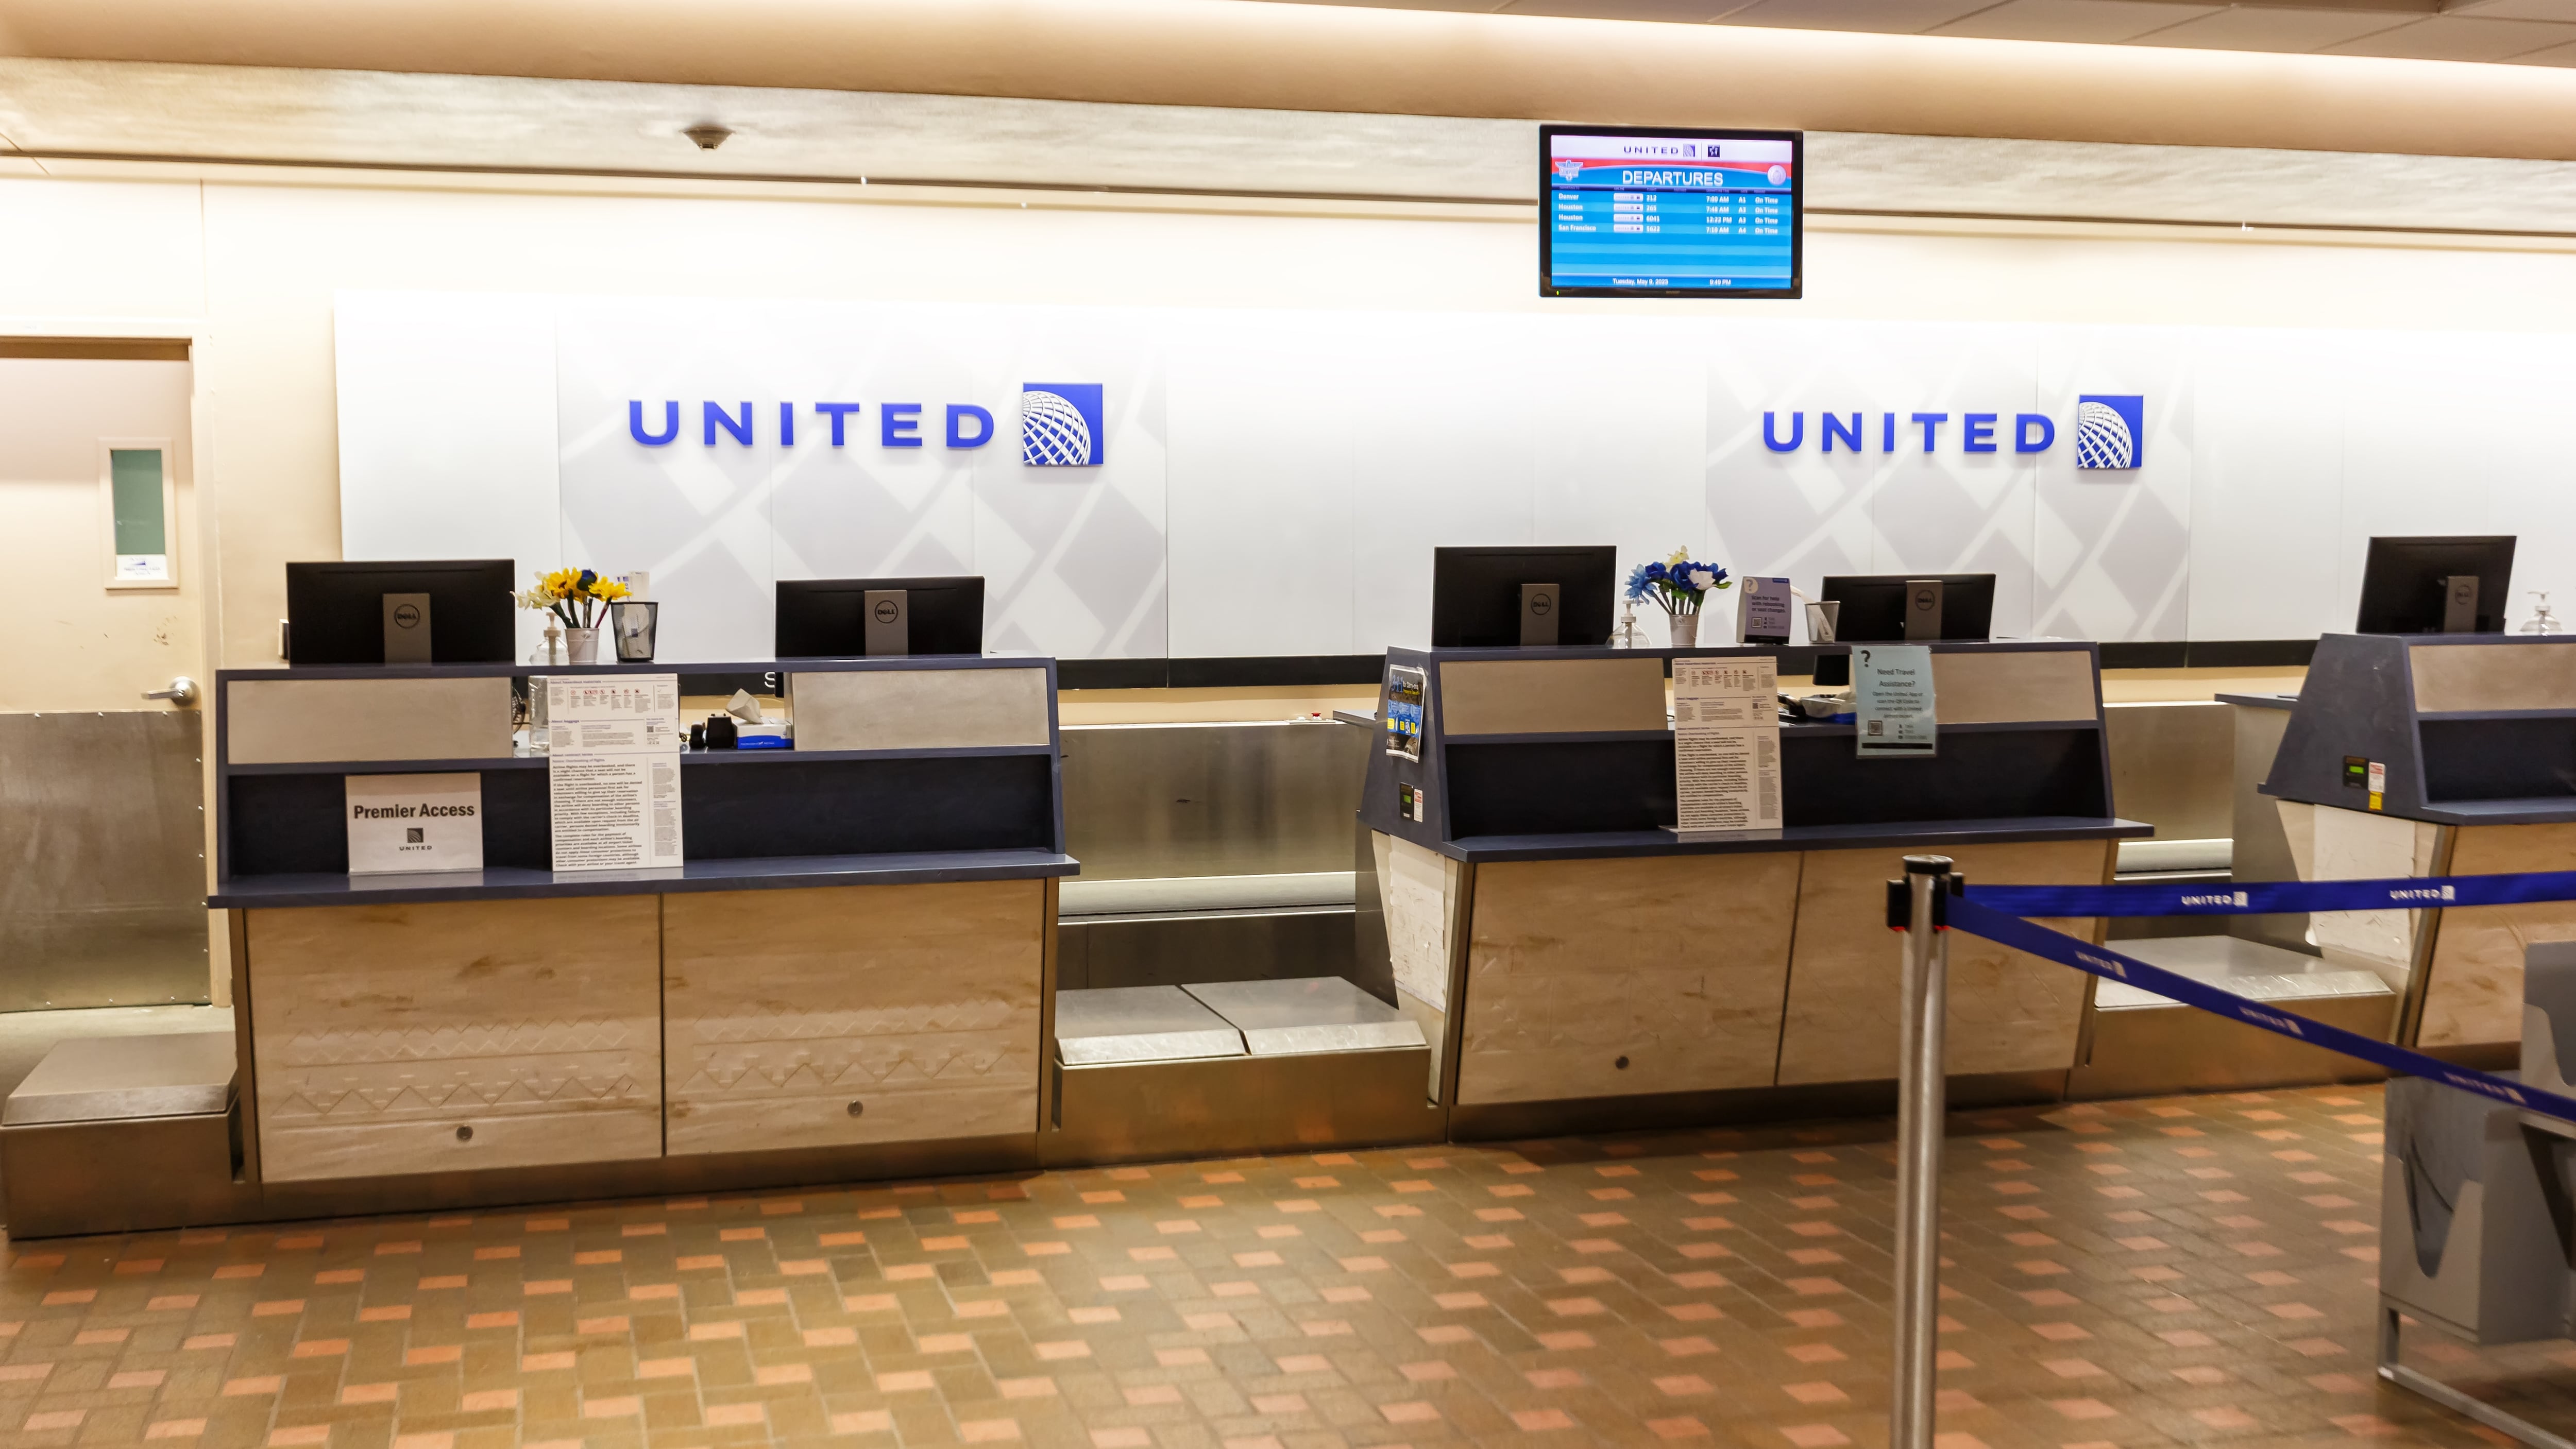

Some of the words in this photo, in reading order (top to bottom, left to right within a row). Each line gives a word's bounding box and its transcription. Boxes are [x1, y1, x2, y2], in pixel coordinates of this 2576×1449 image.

[1624, 146, 1679, 154] UNITED
[1623, 171, 1723, 185] DEPARTURES
[629, 399, 994, 449] UNITED
[1763, 411, 2055, 452] UNITED
[354, 804, 416, 819] Premier
[419, 803, 474, 817] Access
[2181, 895, 2232, 906] UNITED
[2389, 889, 2441, 900] UNITED
